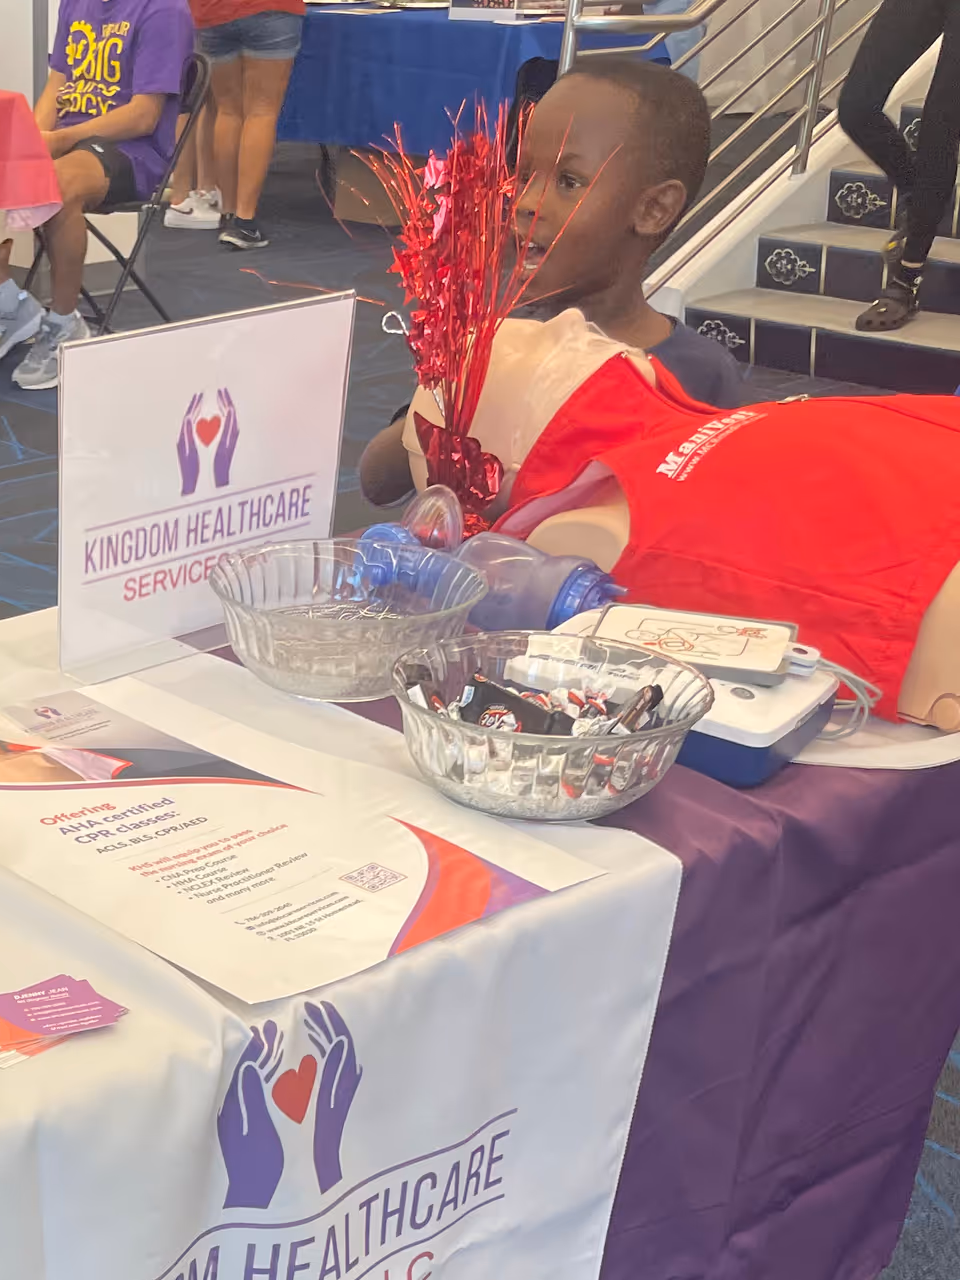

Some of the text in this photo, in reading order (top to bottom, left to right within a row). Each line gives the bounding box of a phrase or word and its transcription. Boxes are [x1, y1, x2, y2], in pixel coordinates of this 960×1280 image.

[84, 517, 179, 576] KINGDOM
[186, 483, 314, 549] HEALTHCARE
[39, 802, 117, 826] Offering
[58, 797, 176, 836] AHA certified
[73, 811, 181, 844] CPR classes:
[95, 816, 208, 854] ACLS, BLS, CPR/AED
[128, 861, 154, 872] KHS
[154, 855, 173, 867] will
[171, 847, 201, 862] equip
[200, 840, 220, 852] you
[217, 836, 232, 845] to
[139, 867, 159, 879] the
[156, 857, 198, 875] nursing
[195, 849, 224, 862] exam
[221, 843, 234, 854] of
[232, 834, 257, 849] your
[160, 853, 239, 883] CNA Prep Course
[171, 866, 229, 889] HHA Course
[182, 866, 251, 895] NCLEX Review
[193, 851, 309, 900] Nurse Practitioner Review
[206, 876, 277, 905] and many more
